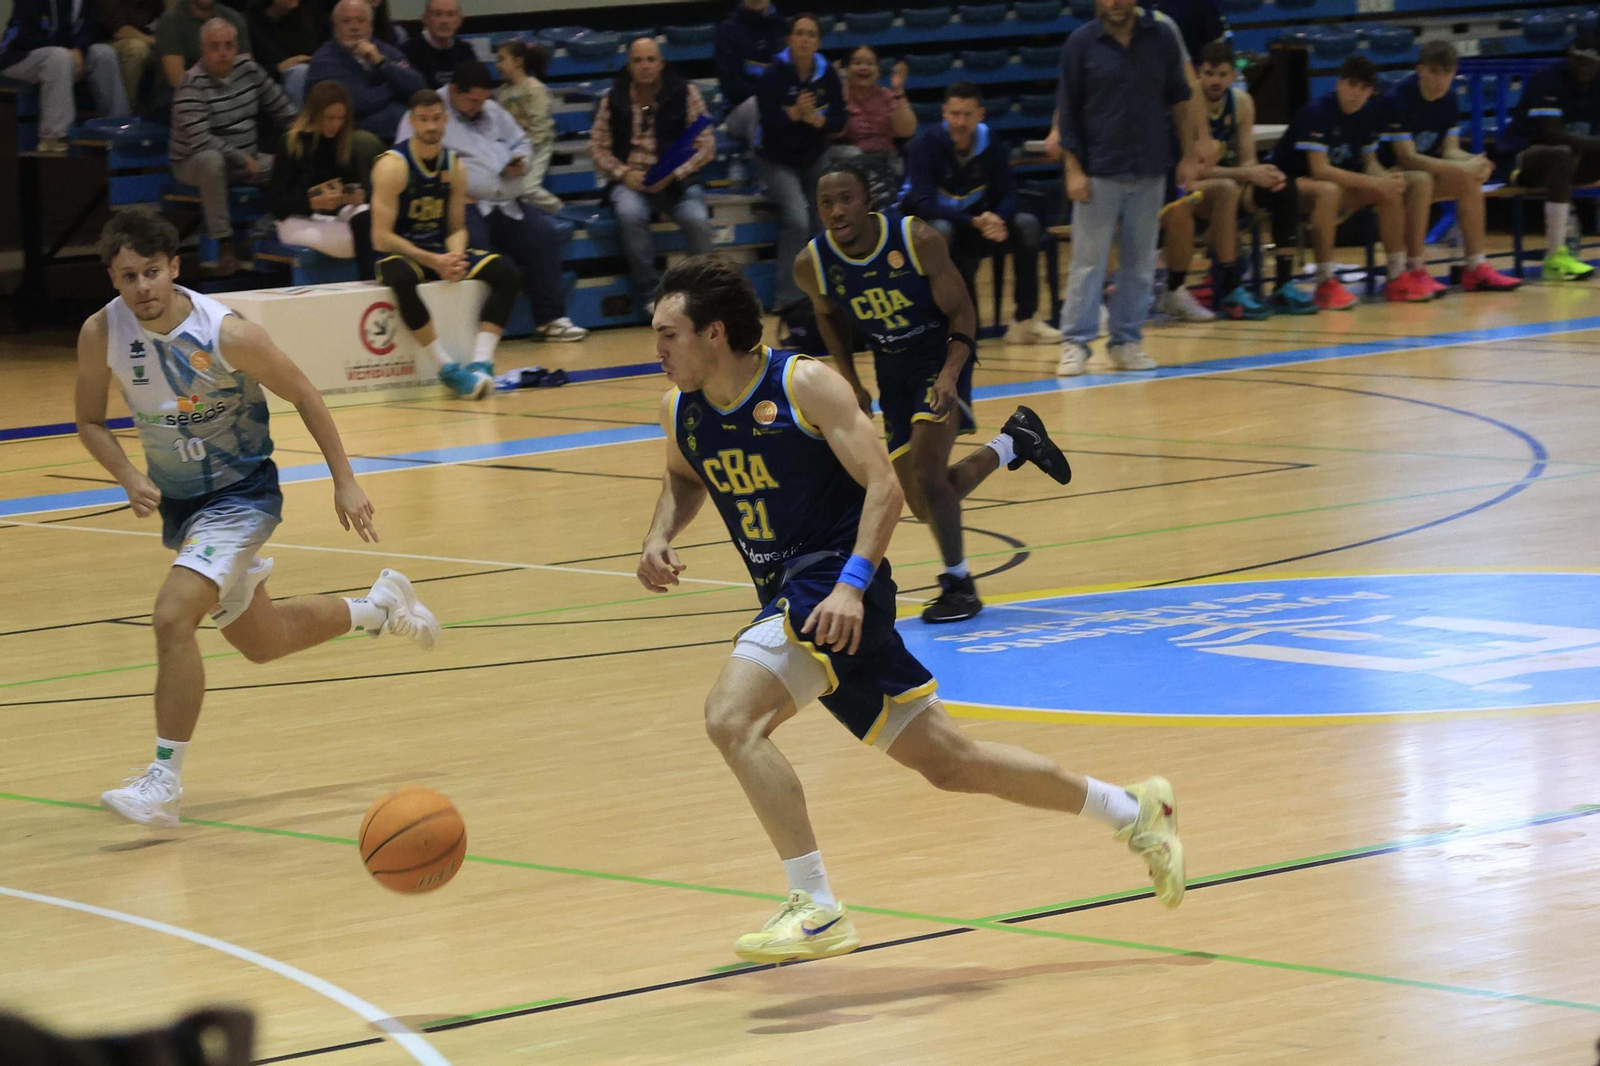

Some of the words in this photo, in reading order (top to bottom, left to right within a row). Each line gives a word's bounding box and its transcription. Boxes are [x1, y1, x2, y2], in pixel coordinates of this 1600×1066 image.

[850, 287, 914, 320] CBA
[172, 437, 207, 463] 10
[702, 448, 779, 495] CBA
[736, 498, 776, 541] 21
